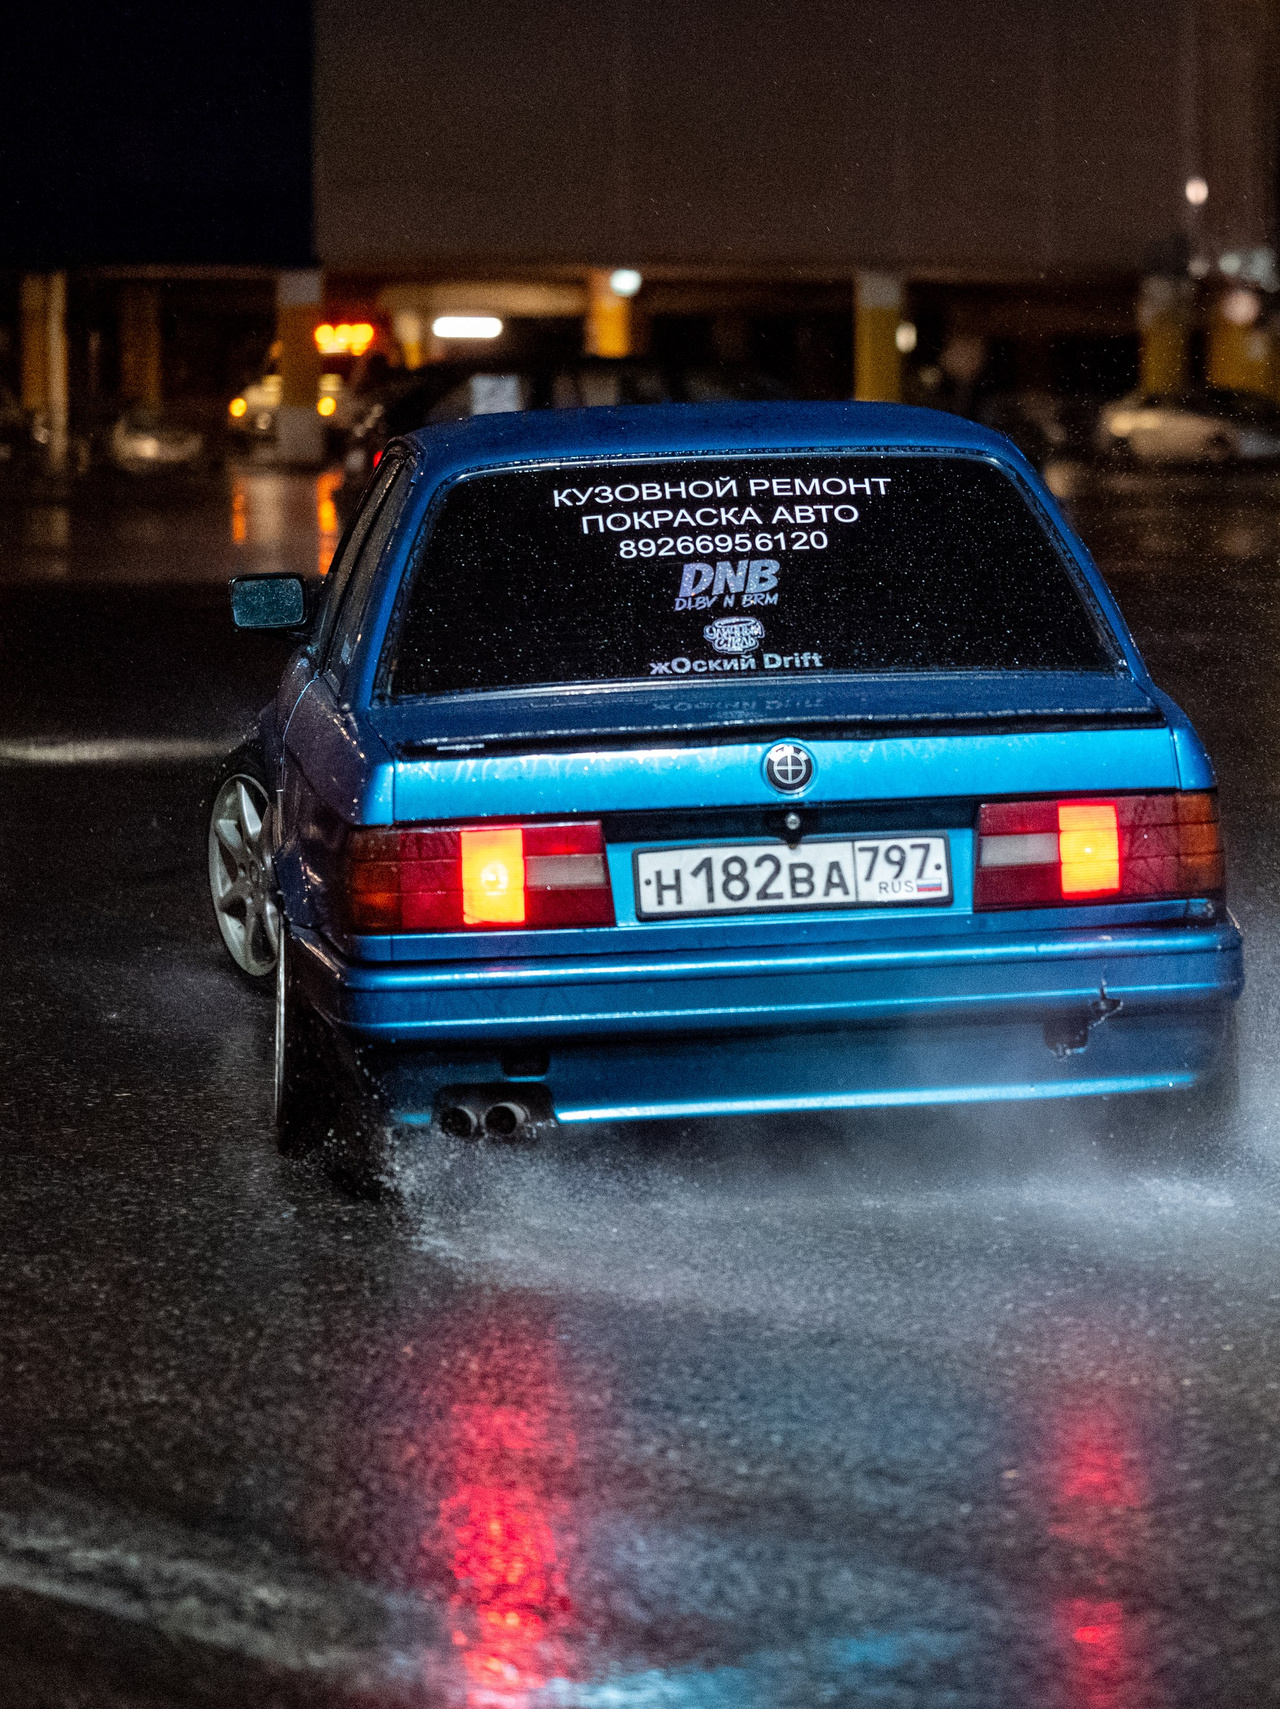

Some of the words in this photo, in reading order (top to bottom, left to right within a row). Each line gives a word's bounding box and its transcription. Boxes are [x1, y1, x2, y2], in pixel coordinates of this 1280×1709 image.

[553, 476, 738, 507] КУЗОВНОЙ
[750, 478, 891, 496] РЕМОНТ
[581, 505, 762, 534] ПОКРАСКА
[772, 504, 859, 525] АВТО
[618, 531, 828, 559] 89266956120
[679, 559, 780, 597] DNB
[723, 594, 735, 608] N
[741, 592, 779, 608] BRM
[763, 652, 823, 669] Drift
[654, 853, 850, 906] Н182ВА
[857, 843, 932, 881] 797
[878, 879, 914, 895] RUS
